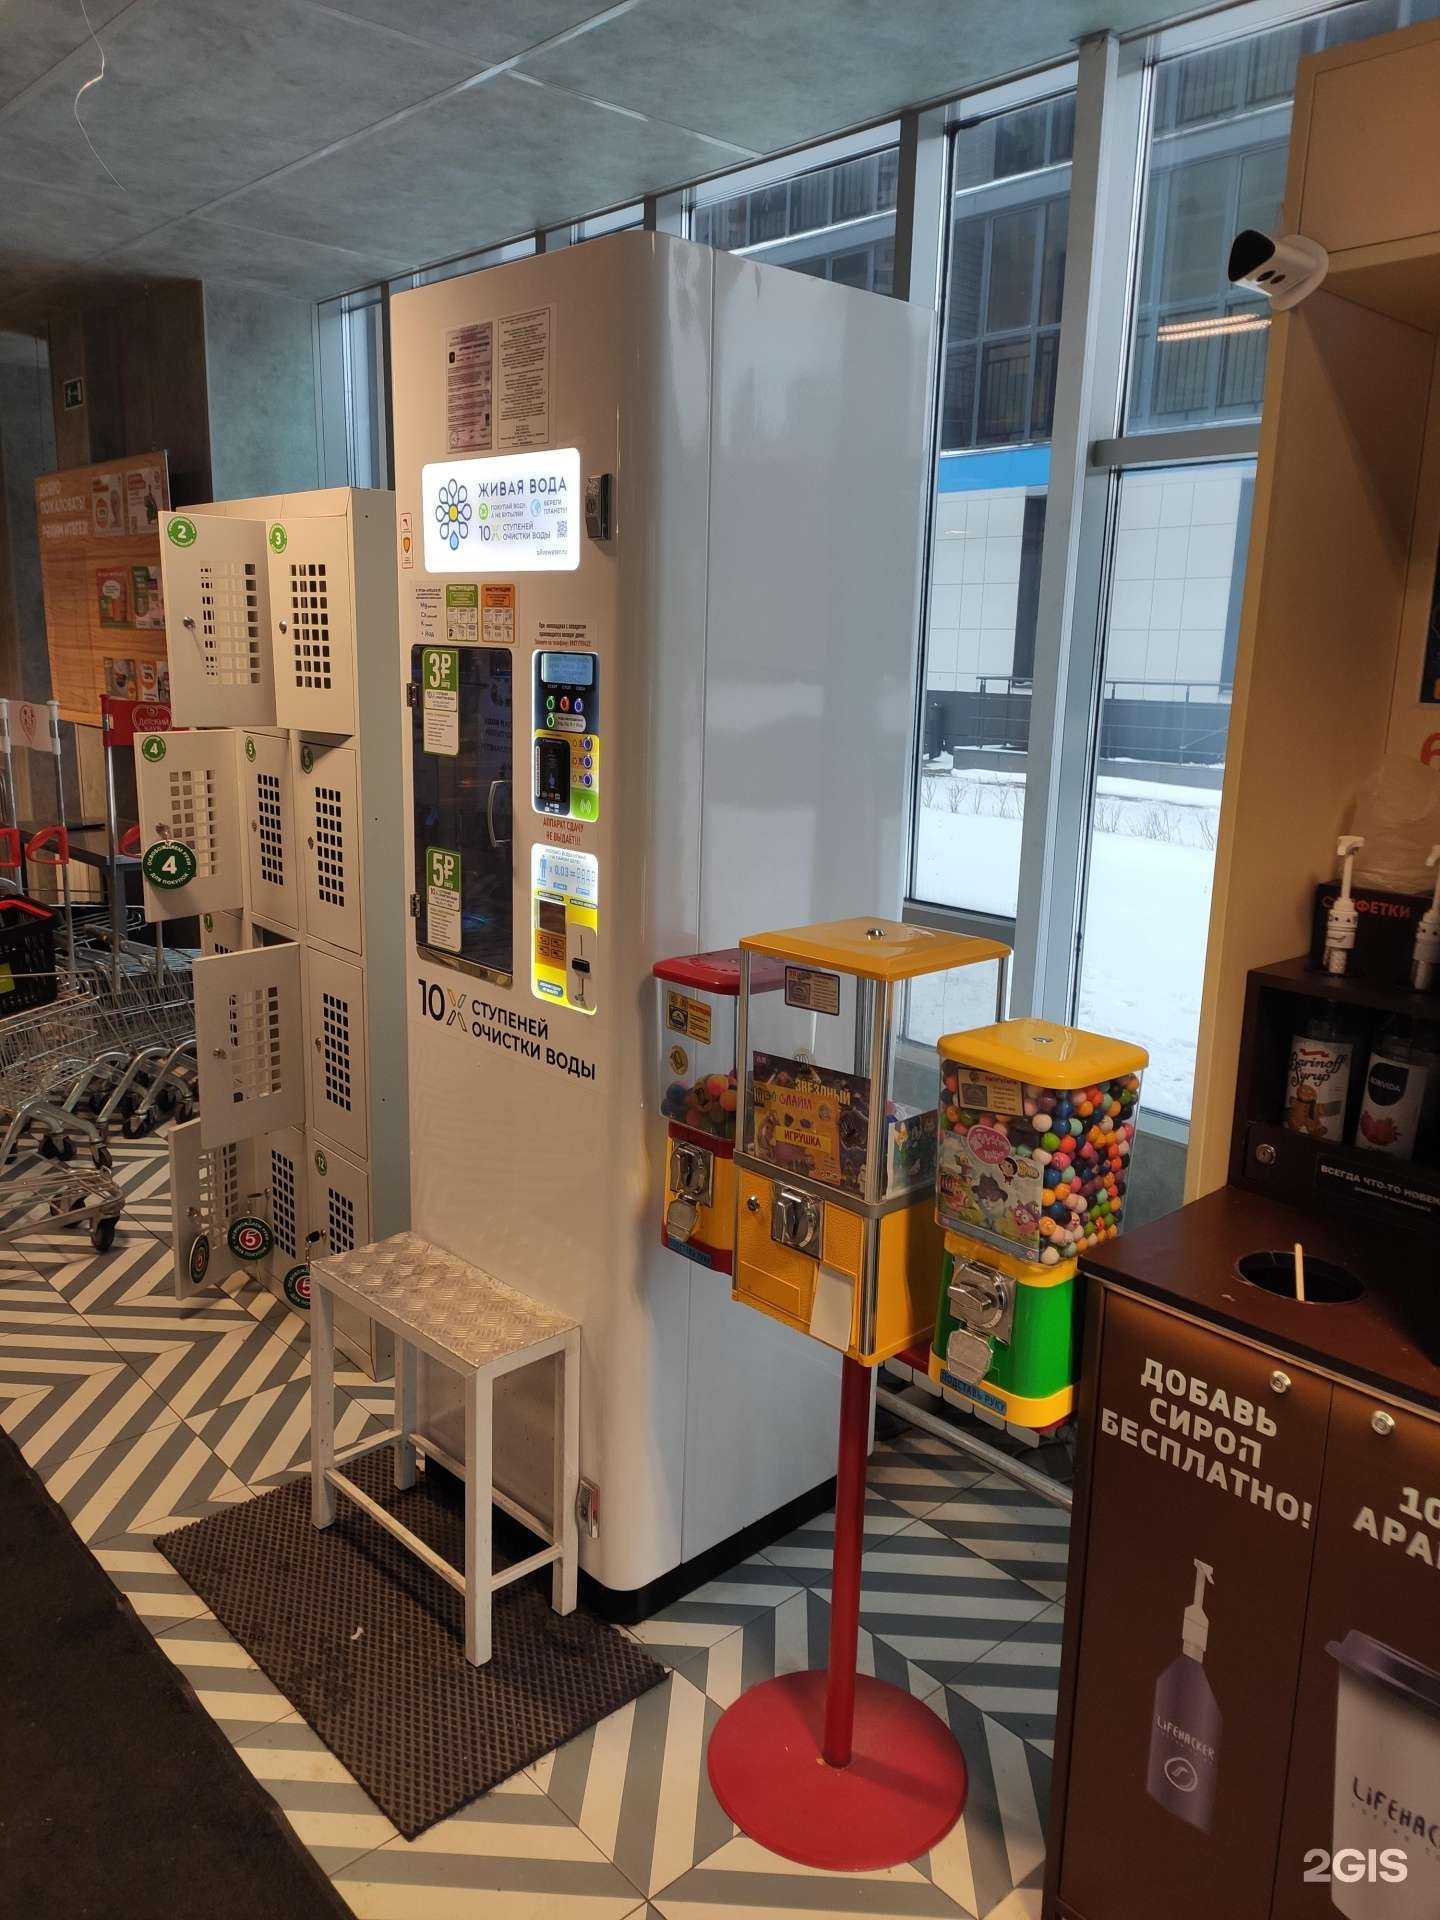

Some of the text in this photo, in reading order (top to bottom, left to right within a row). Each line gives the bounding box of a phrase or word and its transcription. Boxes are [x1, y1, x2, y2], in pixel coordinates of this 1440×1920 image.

[478, 476, 567, 498] ЖИВАЯ ВОДА
[177, 525, 187, 539] 2
[502, 520, 534, 531] СТУПЕНЕЙ
[275, 532, 282, 545] 3
[502, 531, 551, 541] ОЧИСТКИ ВОДЫ
[150, 742, 158, 754] 4
[543, 817, 584, 833] АППАРАТ СДАЧУ
[545, 831, 553, 841] НЕ
[161, 855, 178, 874] 4
[1322, 895, 1411, 918] СФЕТКИ
[471, 1000, 549, 1041] СТУПЕНЕЙ
[471, 1021, 596, 1081] ОЧИСТКИ ВОДЫ
[1291, 1067, 1330, 1087] Syrup
[784, 1130, 822, 1148] ИГРУШКА
[1320, 1164, 1361, 1184] ВСЕГДА
[1363, 1175, 1401, 1194] ЧТО-ТО
[245, 1229, 256, 1247] 5
[1141, 1357, 1278, 1438] ДОБАВЬ
[1150, 1397, 1262, 1469] СИРОП
[1101, 1407, 1313, 1529] БЕСПЛАТНО!
[1352, 1505, 1440, 1571] АРА
